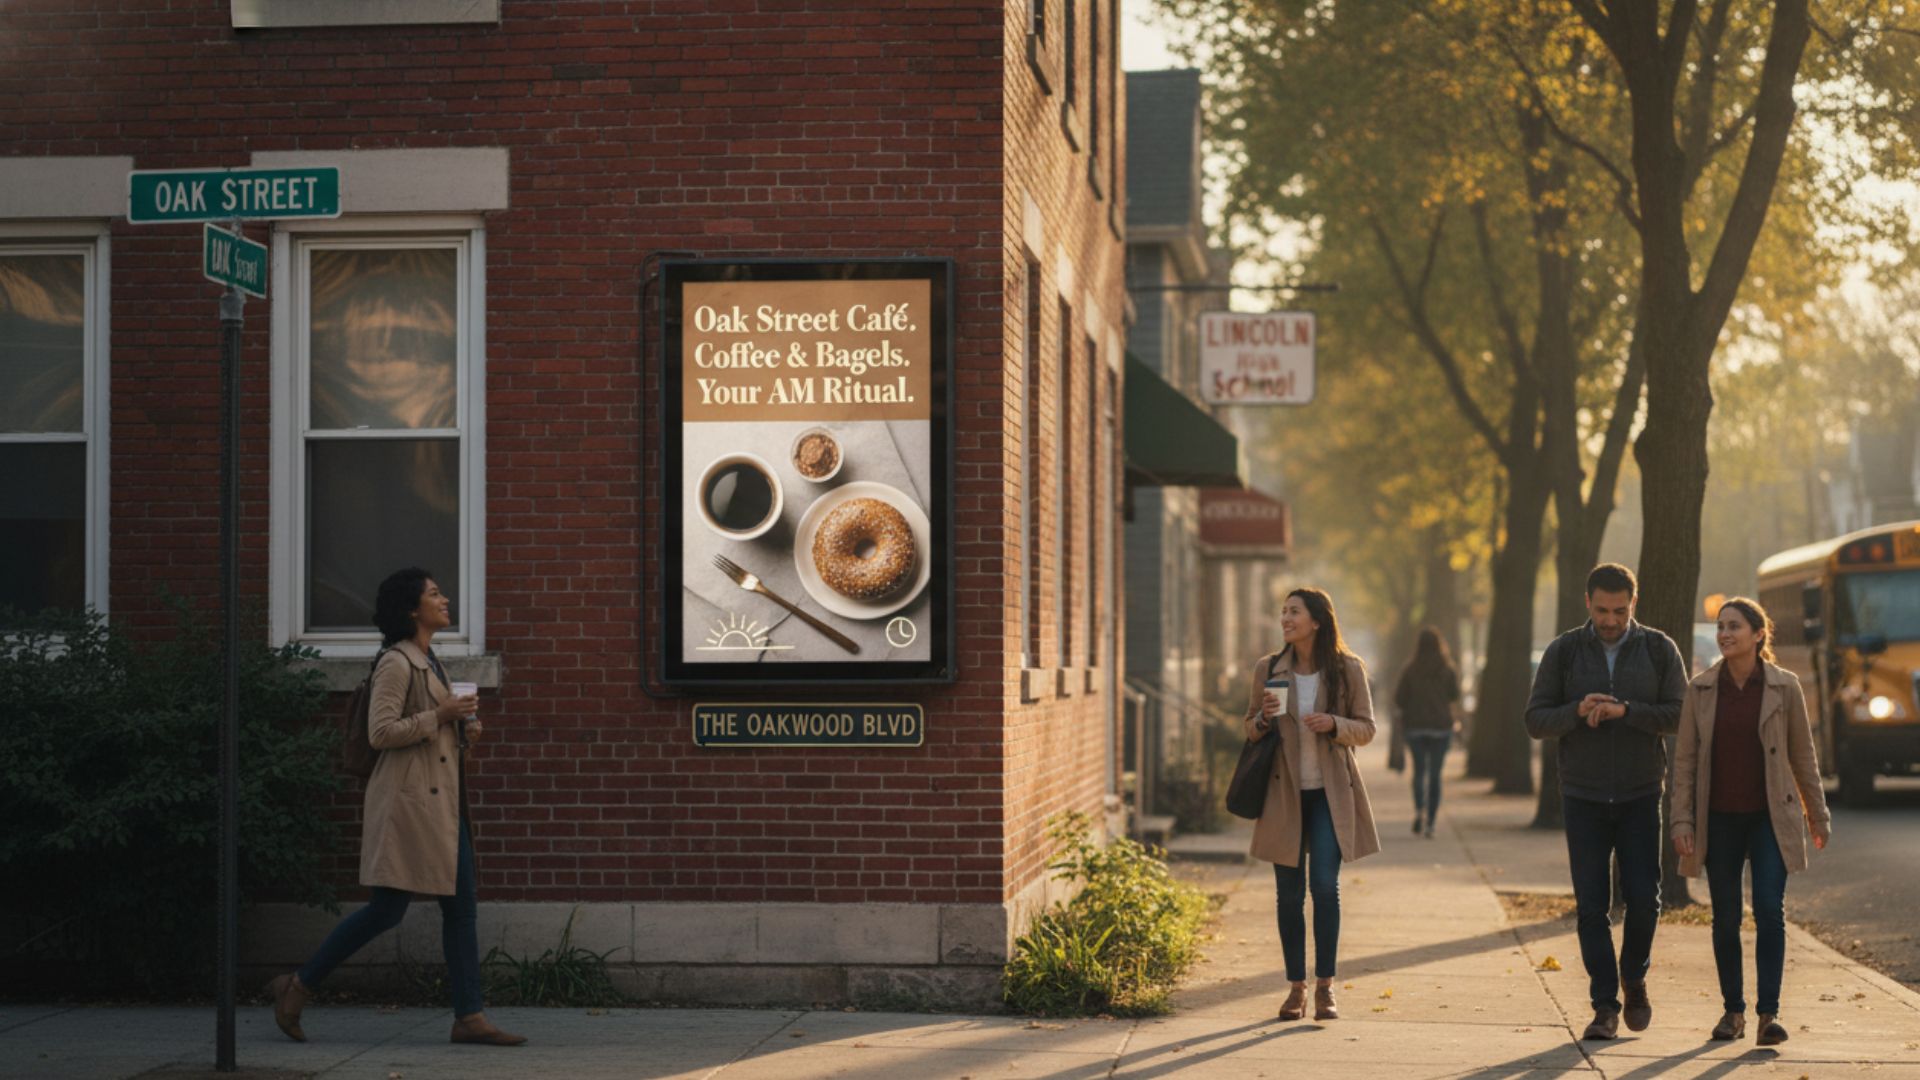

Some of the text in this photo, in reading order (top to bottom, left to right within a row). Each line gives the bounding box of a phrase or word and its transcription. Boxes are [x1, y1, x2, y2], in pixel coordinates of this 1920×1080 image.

[155, 177, 318, 213] OAK STREET
[694, 302, 917, 333] Oak Street Café.
[1206, 318, 1309, 347] LINCOLN
[694, 339, 911, 375] Coffee & Bagels.
[697, 376, 915, 405] Your AM Ritual.
[699, 713, 916, 736] THE OAKWOOD BLVD
